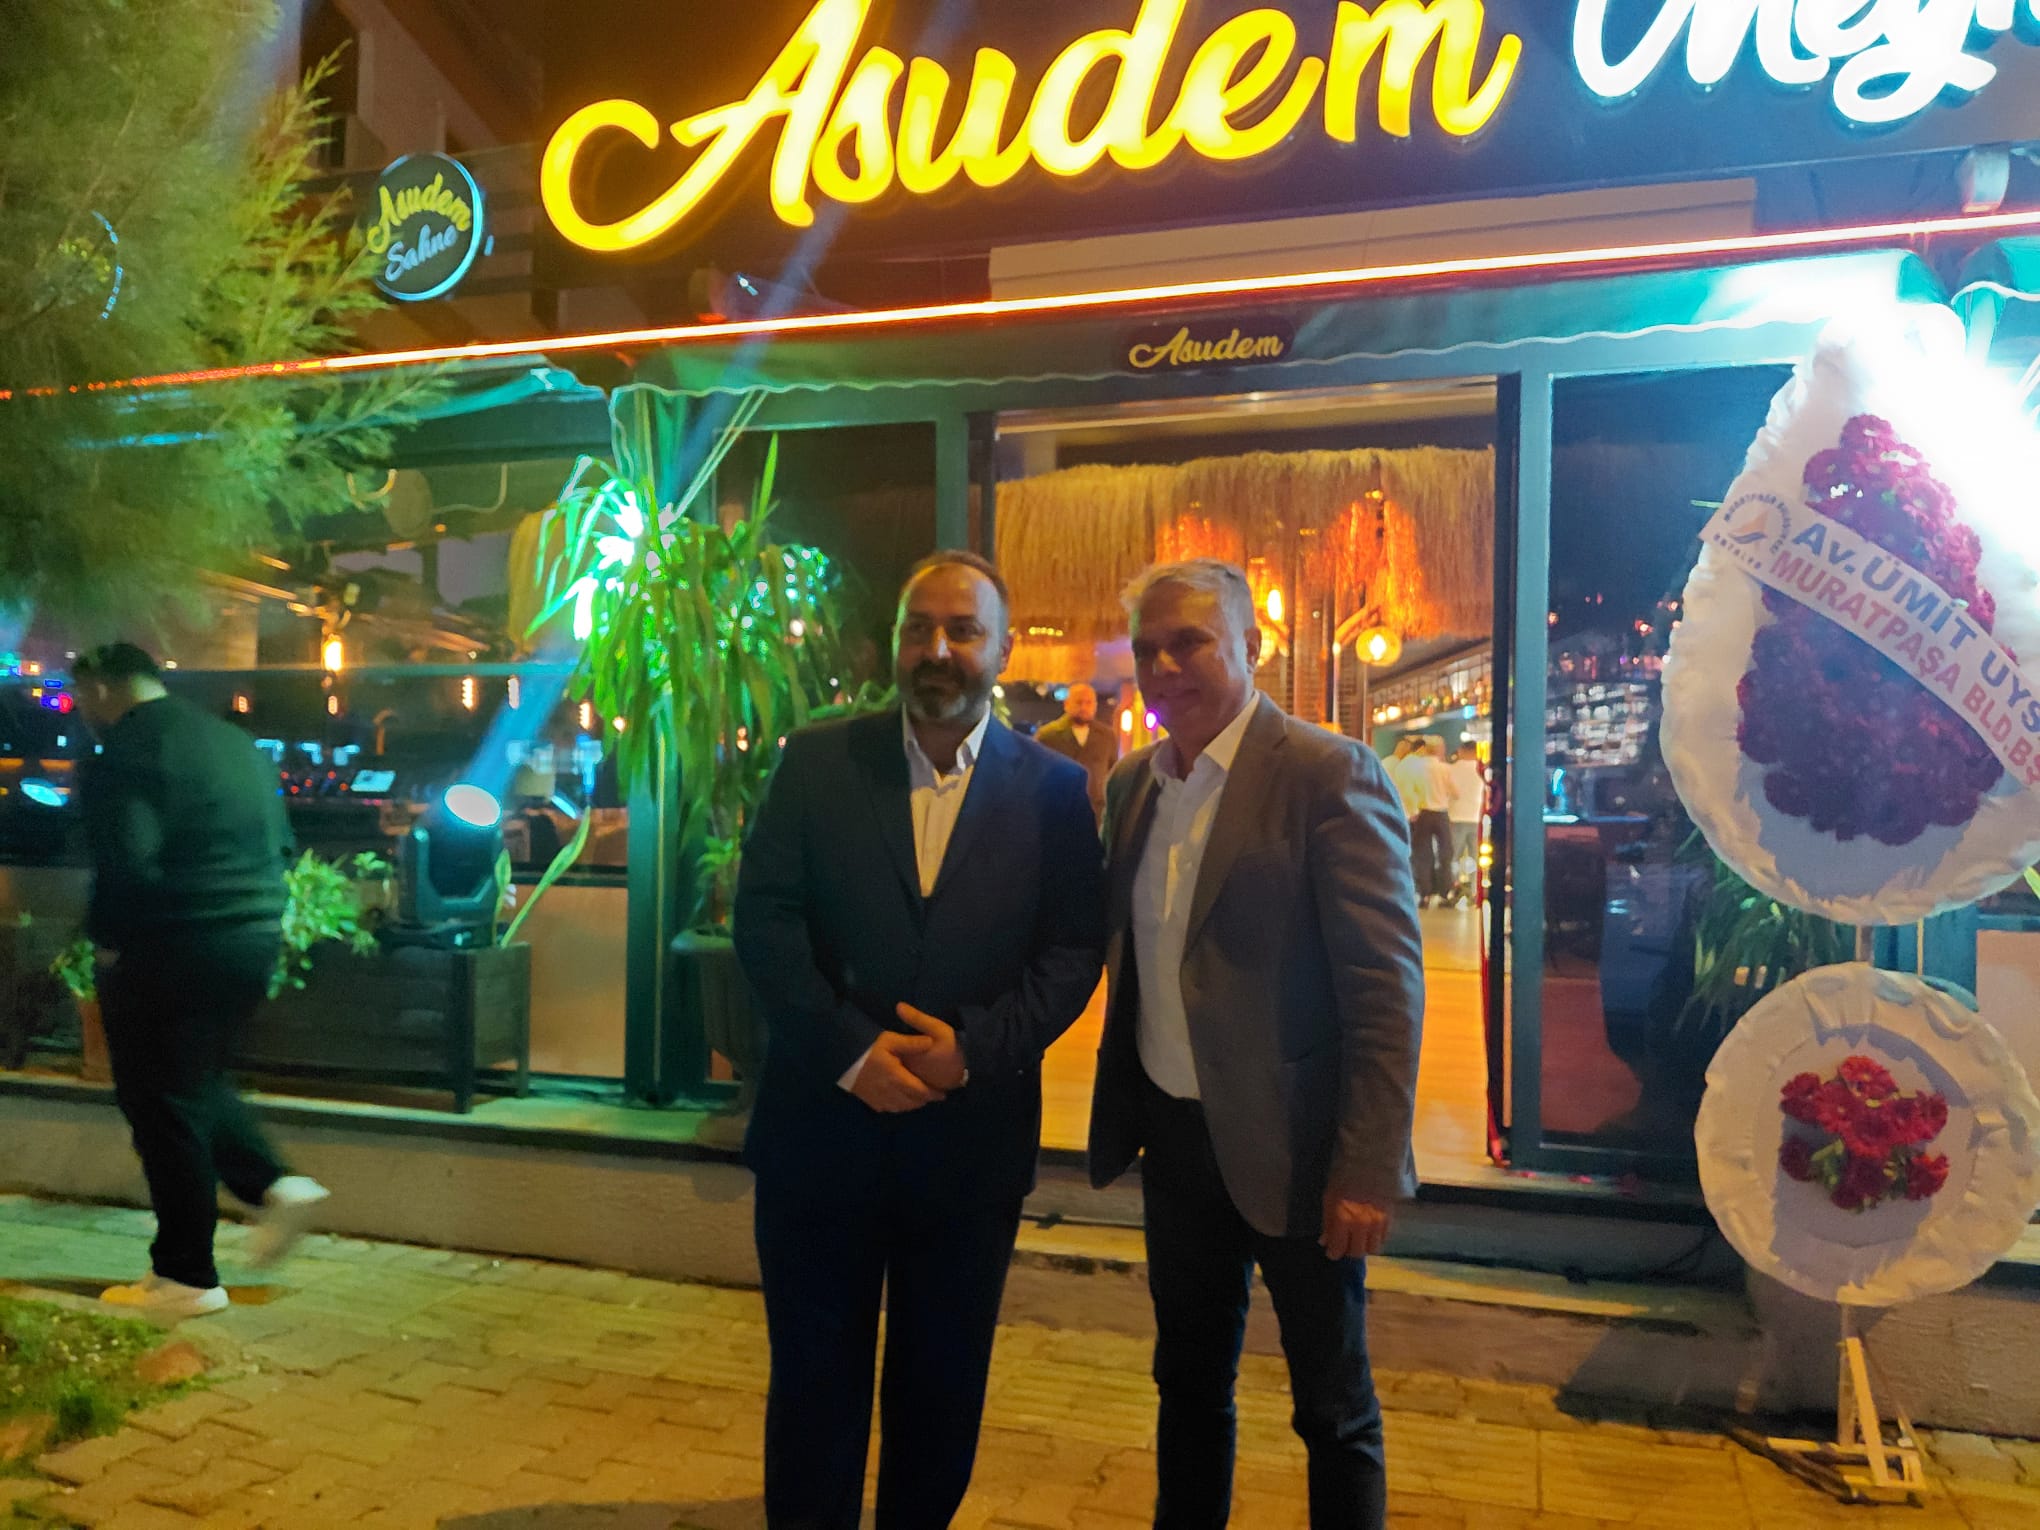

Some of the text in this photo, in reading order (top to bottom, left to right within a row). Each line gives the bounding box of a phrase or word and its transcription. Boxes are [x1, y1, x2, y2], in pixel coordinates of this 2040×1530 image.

[540, 0, 1521, 252] Asudem
[367, 171, 471, 254] Asudem
[1128, 326, 1284, 369] Asudem
[1768, 550, 1961, 694] MURATPAŞA
[1980, 649, 2040, 740] UYS
